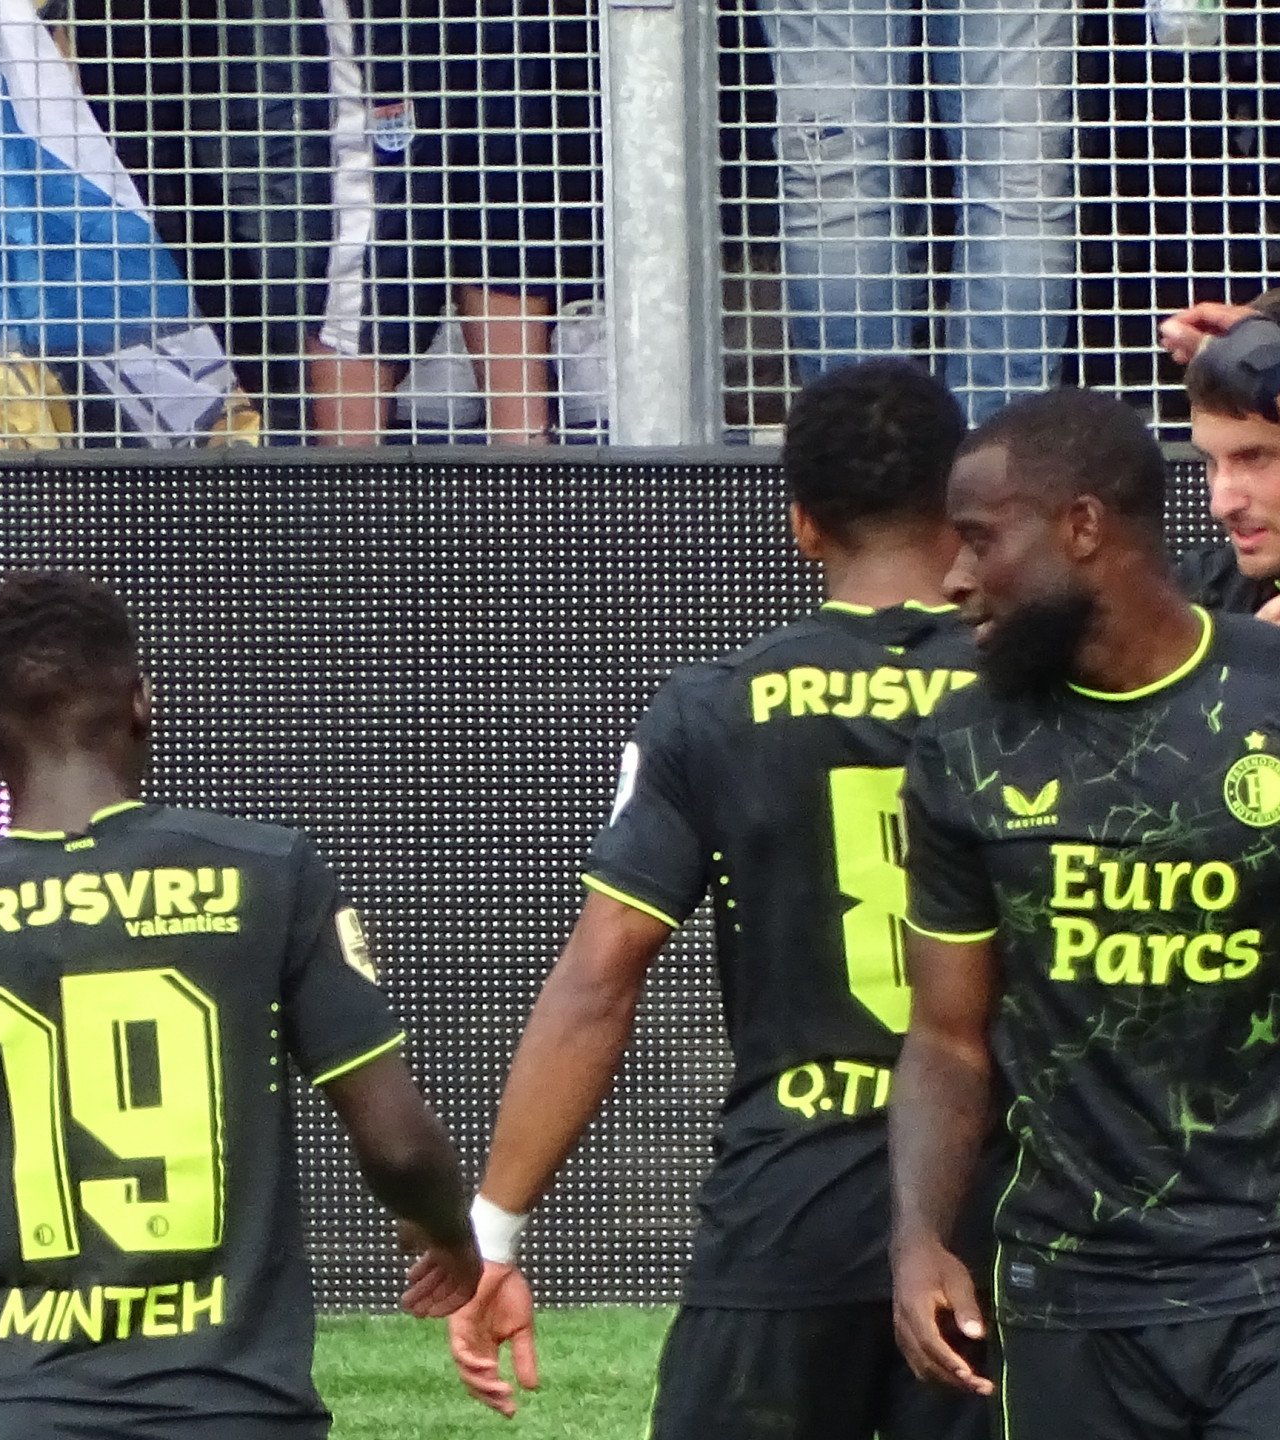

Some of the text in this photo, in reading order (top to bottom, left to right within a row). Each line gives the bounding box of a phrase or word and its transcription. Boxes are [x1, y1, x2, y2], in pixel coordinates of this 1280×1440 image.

[749, 665, 979, 724] PRIJSV
[1049, 843, 1237, 911] Euro
[125, 914, 240, 938] vakanties
[1049, 915, 1263, 985] Parcs
[776, 1059, 894, 1120] Q.TI
